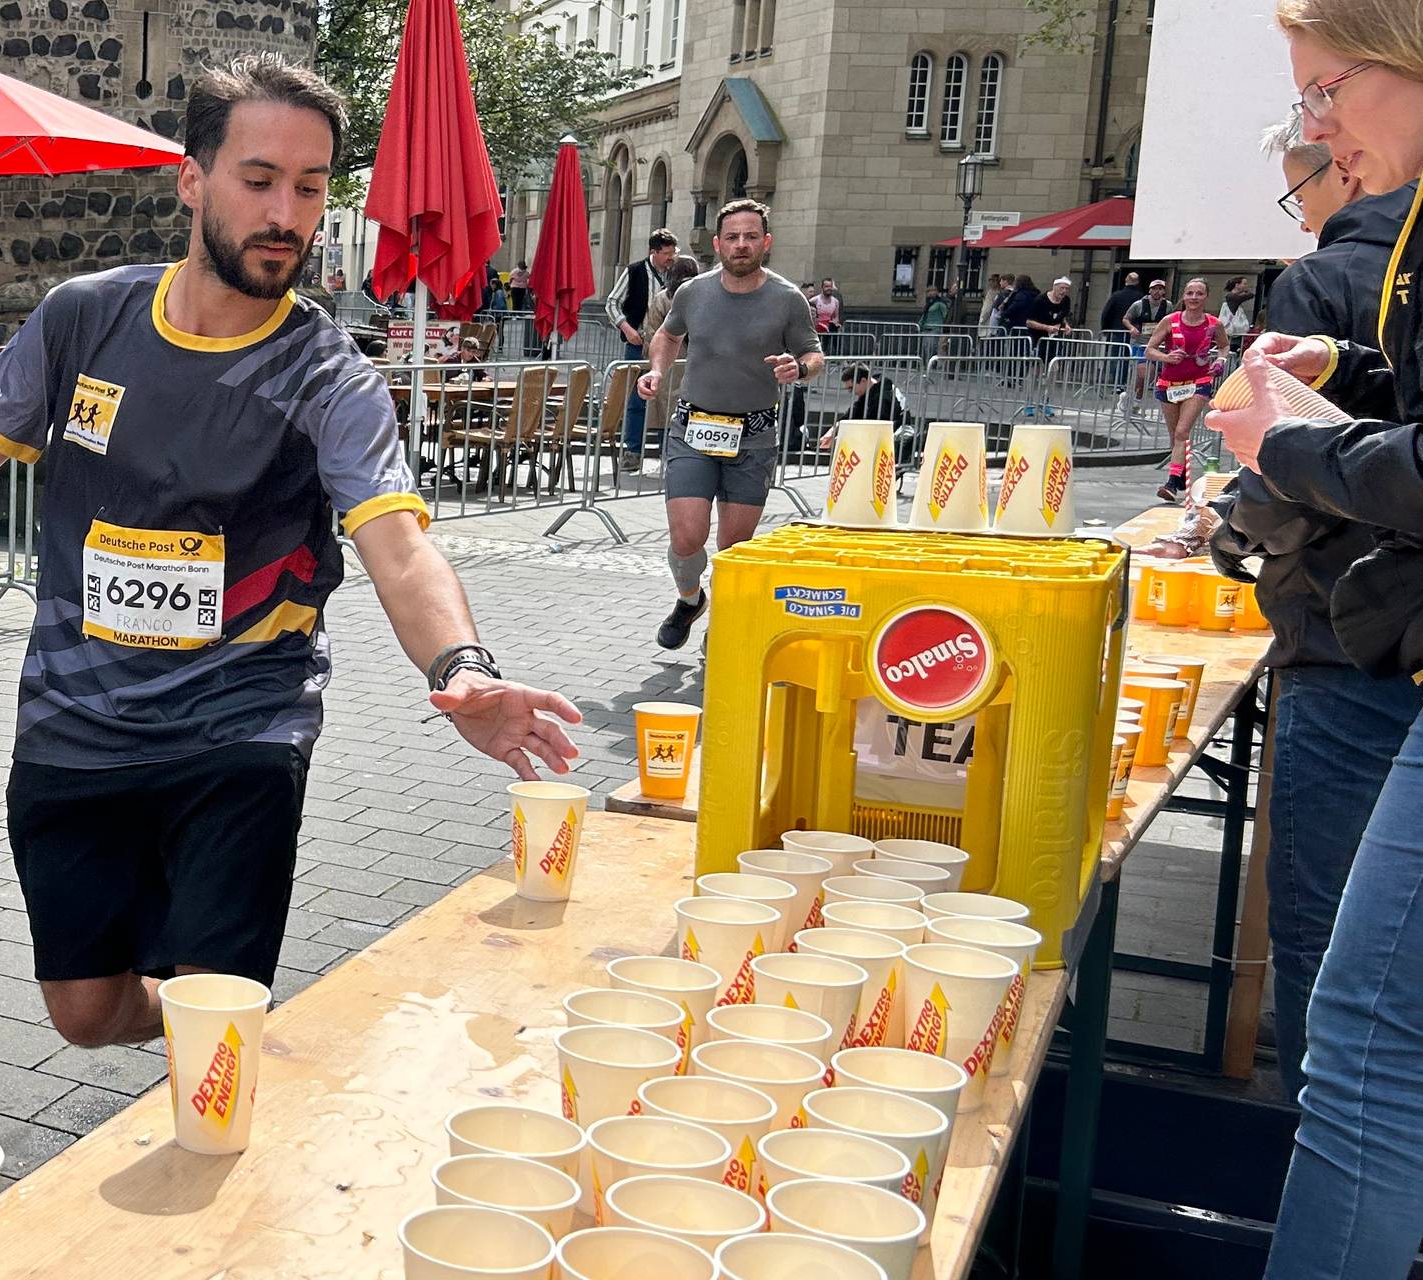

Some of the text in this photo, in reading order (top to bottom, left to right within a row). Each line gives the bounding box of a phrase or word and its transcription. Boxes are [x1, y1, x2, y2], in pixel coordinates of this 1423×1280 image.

[696, 428, 730, 442] 6059
[833, 450, 861, 504] DEXTRO
[875, 449, 889, 502] ENERGY
[882, 451, 894, 505] EXTRO
[933, 452, 953, 505] ENERGY
[938, 453, 969, 509] DEXTRO
[1000, 455, 1030, 511] DEXTRO
[1045, 455, 1062, 510] ENERGY
[1052, 455, 1072, 514] DEXTRO
[93, 552, 209, 573] Deutsche Post Marathon Bonn
[99, 533, 175, 552] Deutsche Post
[106, 576, 192, 612] 6296
[785, 587, 843, 600] SCHMECKT
[788, 602, 857, 617] DIE SINALCO
[113, 631, 179, 647] MARATHON
[115, 613, 173, 632] FRANCO
[885, 633, 979, 683] Sinalco
[538, 820, 568, 875] DEXTRO
[554, 822, 573, 875] ENERGY
[923, 1006, 942, 1056] NERGY
[962, 1004, 1003, 1078] DEXTRO
[191, 1041, 228, 1118] DEXTRO
[213, 1047, 237, 1119] ENERGY
